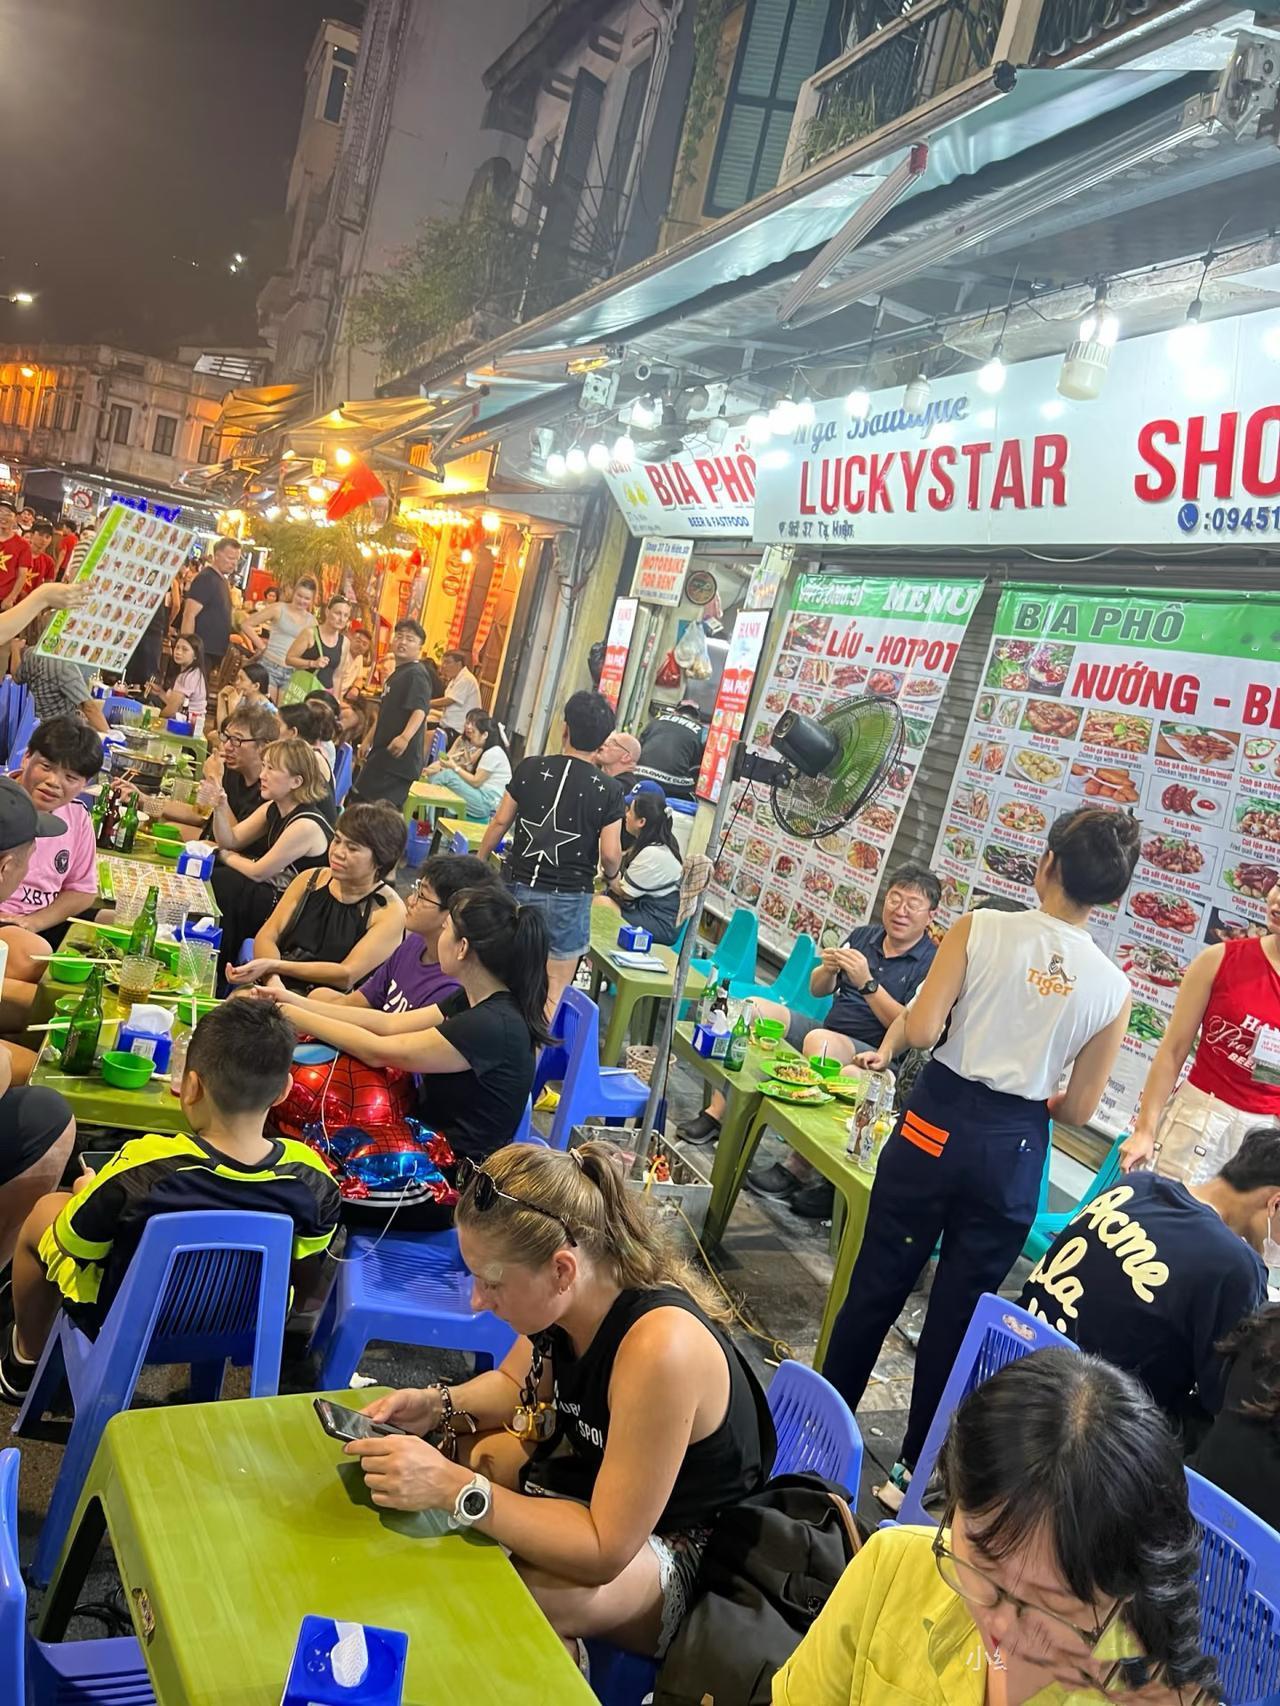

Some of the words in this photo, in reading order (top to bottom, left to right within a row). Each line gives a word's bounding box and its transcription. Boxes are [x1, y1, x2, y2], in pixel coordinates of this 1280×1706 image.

[645, 461, 703, 506] BIA
[800, 433, 1068, 515] LUCKYSTAR
[688, 516, 705, 527] BEER
[711, 516, 749, 527] FASTFOOD
[803, 521, 813, 537] 37
[642, 555, 686, 573] MOTORBIKE
[641, 572, 656, 588] FOR
[656, 574, 676, 591] RENT
[881, 583, 978, 616] MENU
[1014, 602, 1078, 635] BIA
[876, 634, 961, 674] HOTPOT
[1071, 661, 1201, 716] NƯỚNG
[631, 782, 642, 794] C
[1157, 767, 1177, 777] Chicken
[1069, 1185, 1170, 1304] Acme
